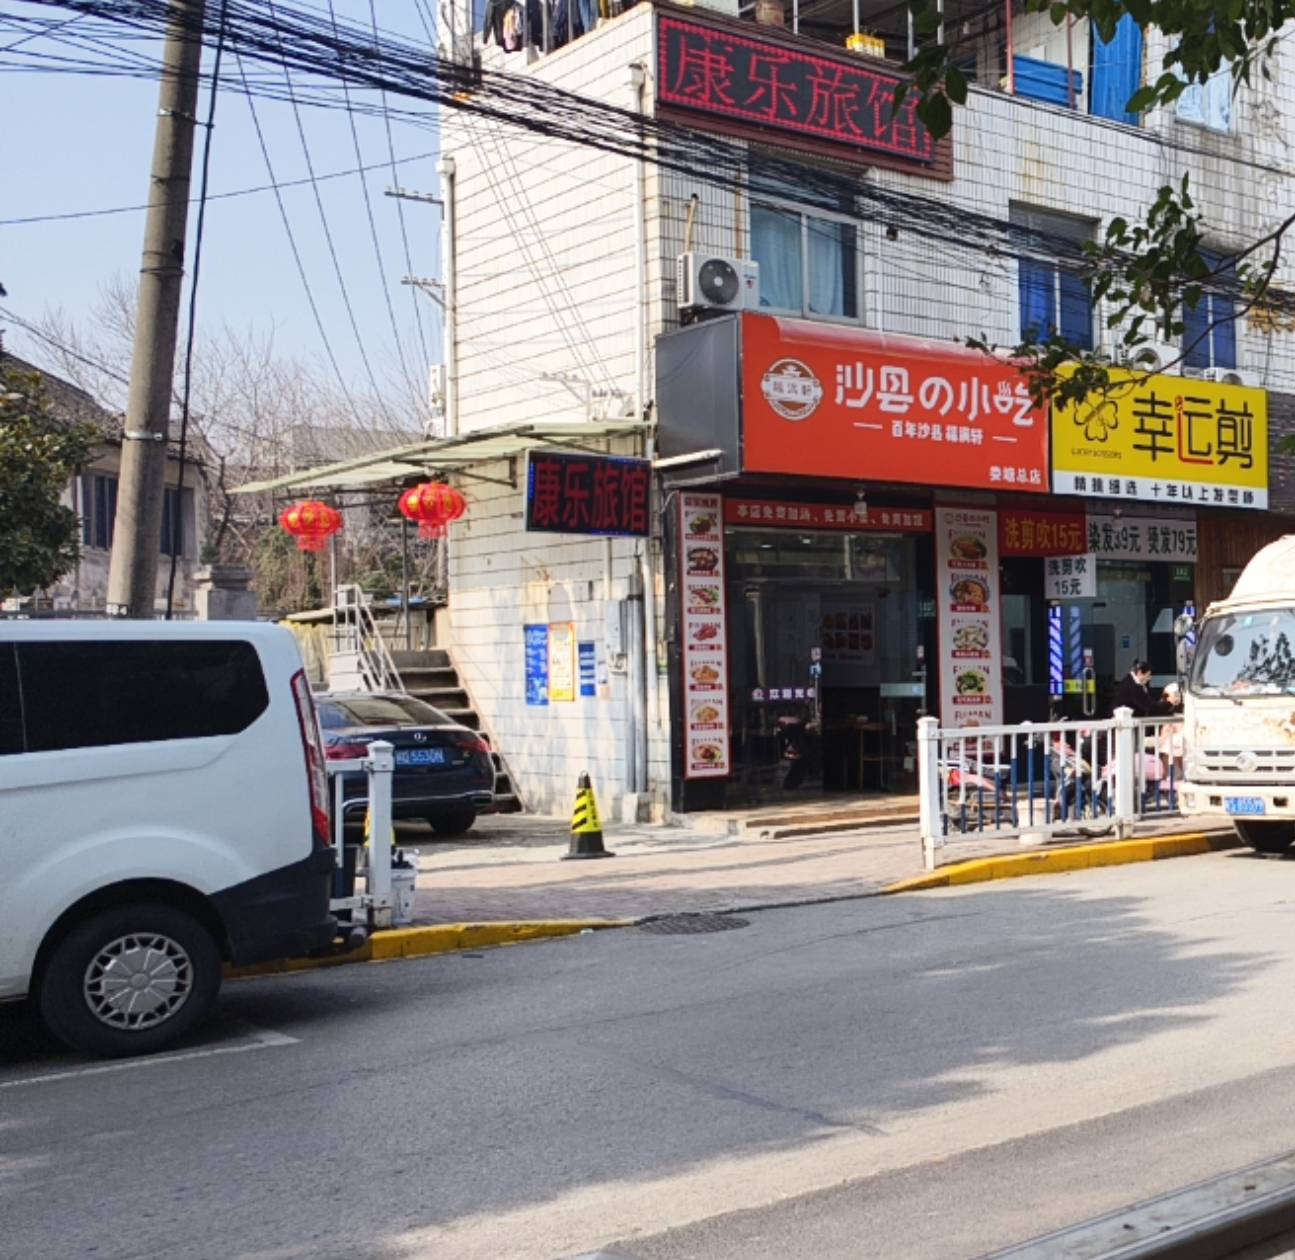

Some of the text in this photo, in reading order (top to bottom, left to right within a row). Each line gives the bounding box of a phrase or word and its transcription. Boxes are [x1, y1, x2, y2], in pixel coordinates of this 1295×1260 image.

[673, 34, 920, 151] 康乐旅馆
[834, 361, 1034, 427] 沙县の小吃
[1132, 391, 1254, 469] 幸运剪
[532, 461, 647, 531] 康乐旅馆
[1005, 518, 1083, 550] 洗剪吹15元
[1048, 557, 1087, 575] 洗剪吹
[1054, 577, 1082, 596] 15元
